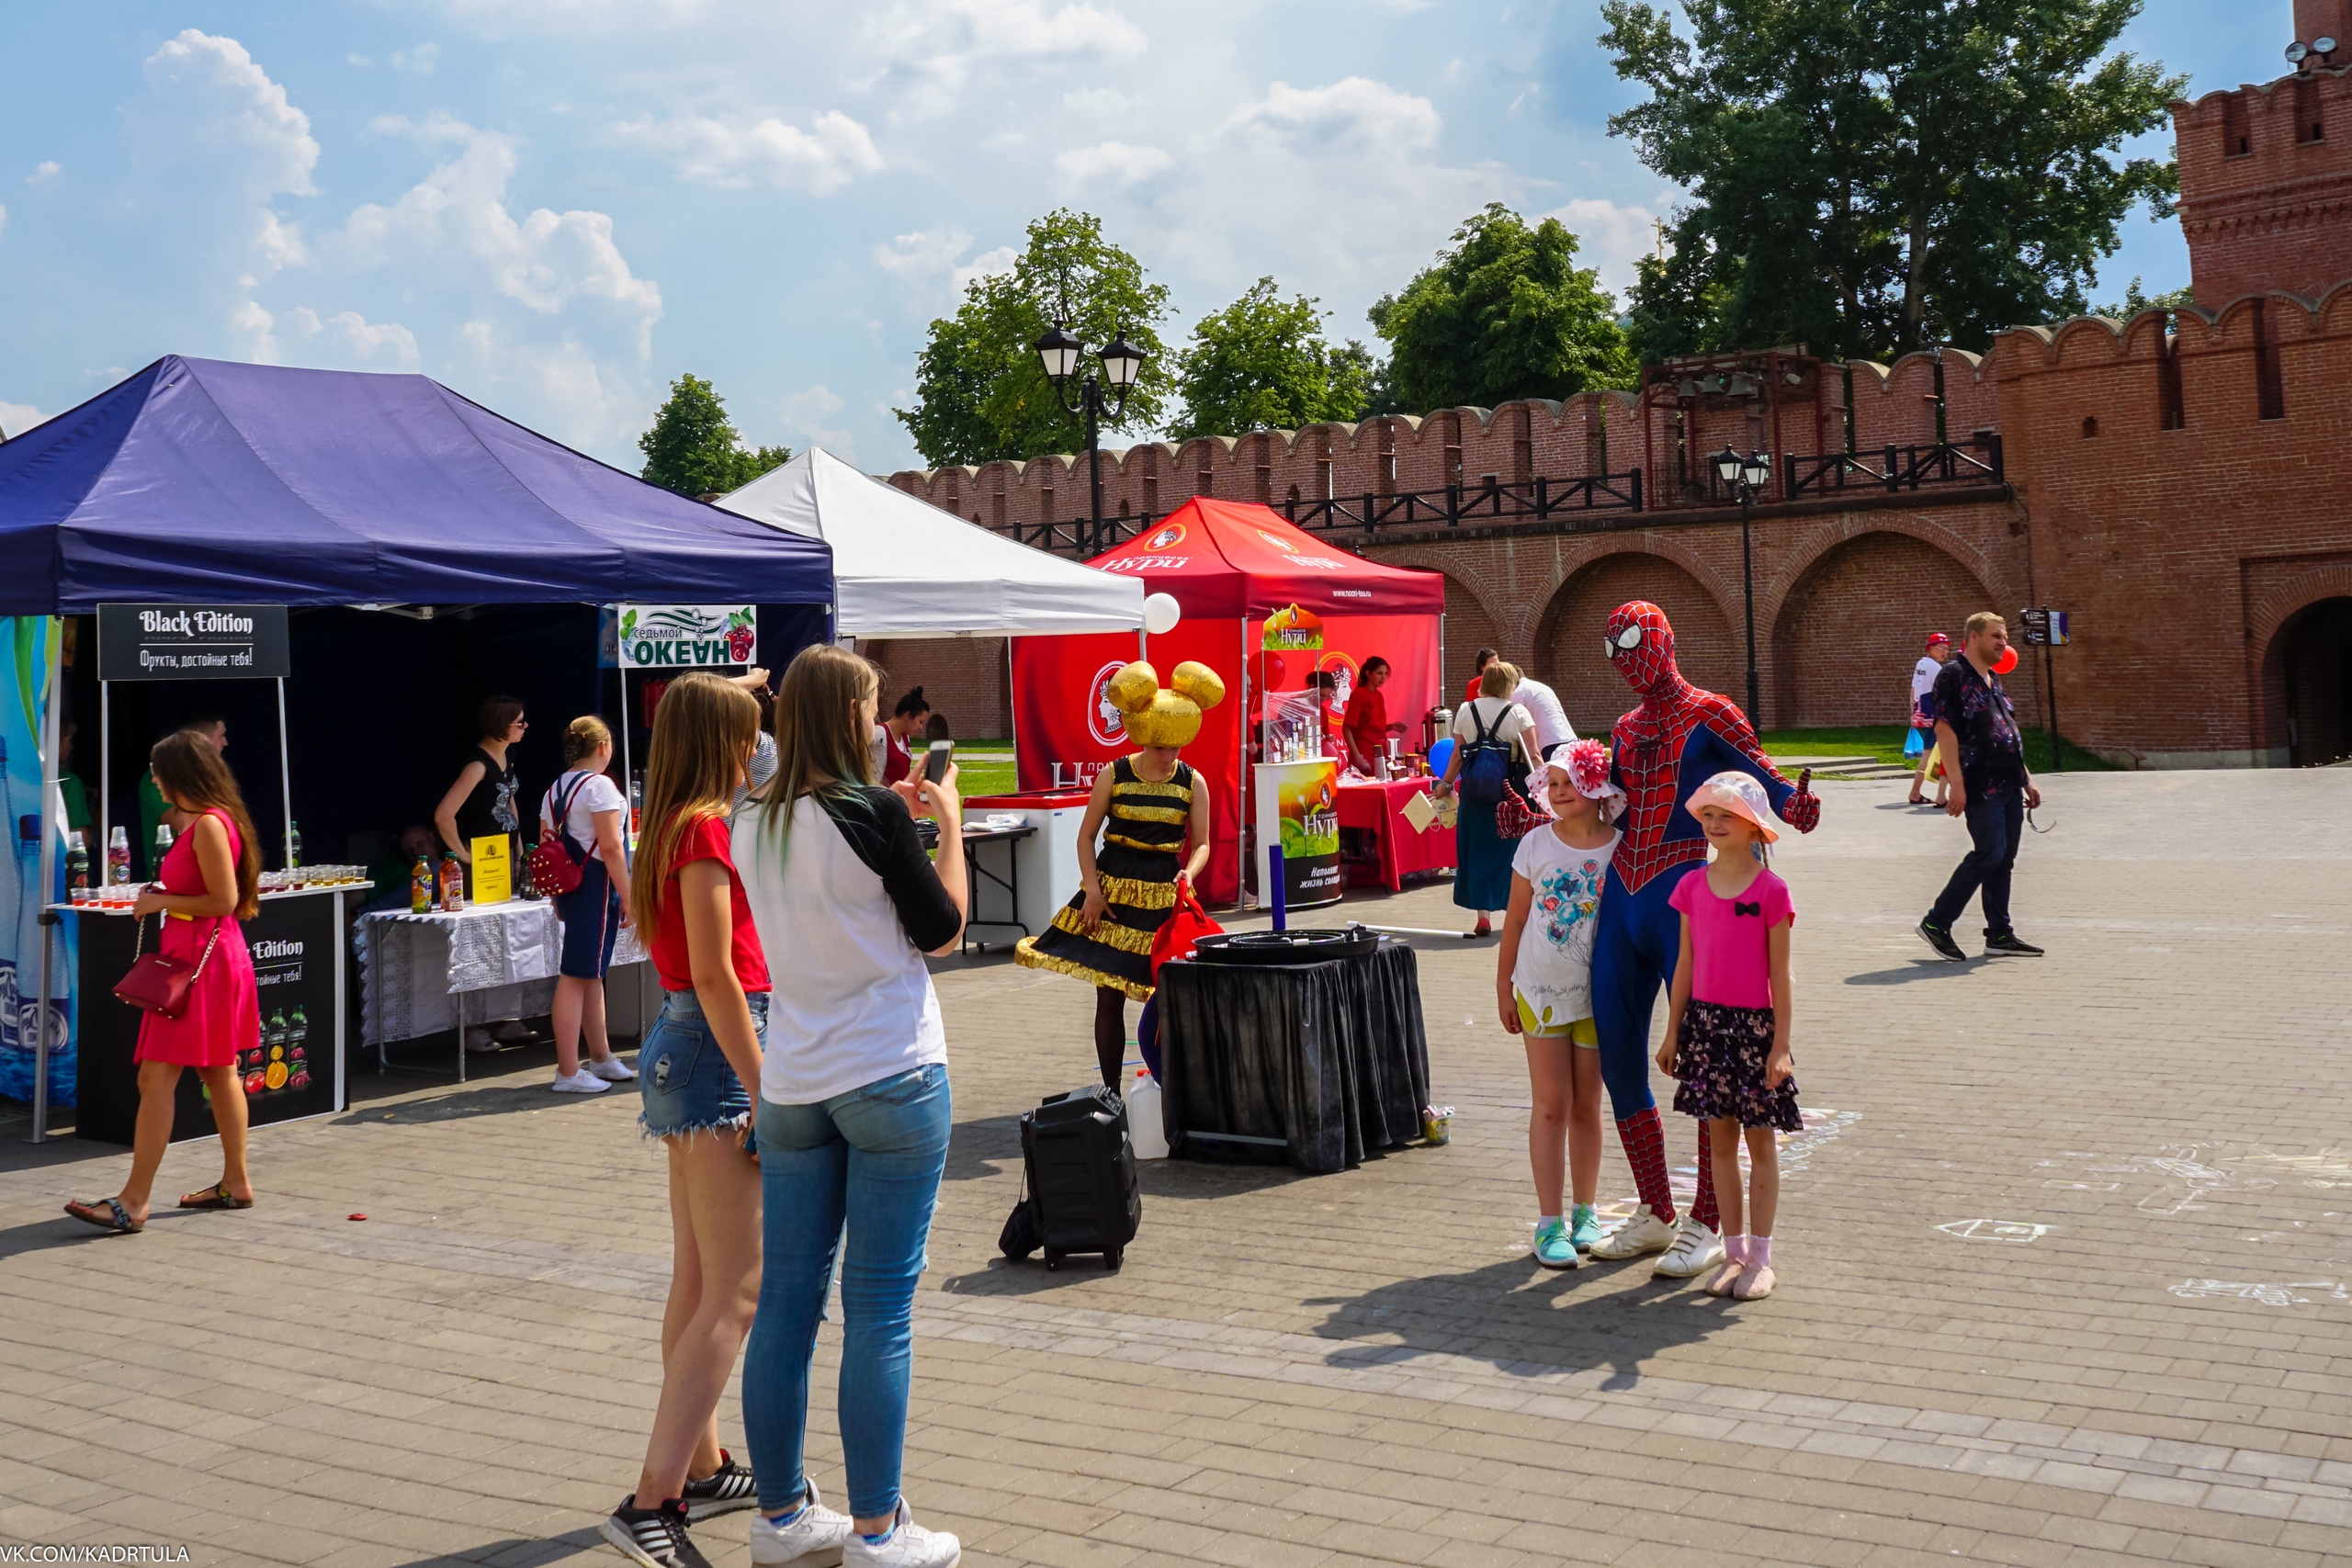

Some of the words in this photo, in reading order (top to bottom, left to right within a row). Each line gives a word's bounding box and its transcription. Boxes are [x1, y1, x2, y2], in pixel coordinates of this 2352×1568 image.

[1100, 558, 1187, 571] Нури
[139, 610, 195, 637] Black
[194, 611, 254, 634] Edition
[634, 628, 683, 640] седьмой
[1281, 628, 1306, 648] Нури
[140, 649, 179, 672] Фрукты,
[181, 653, 228, 668] достойные
[230, 647, 253, 666] тебя!
[1304, 814, 1338, 840] Нури
[1299, 878, 1323, 888] жизнь
[253, 940, 304, 959] Edition
[255, 975, 281, 987] тойные
[283, 964, 302, 982] тебя!
